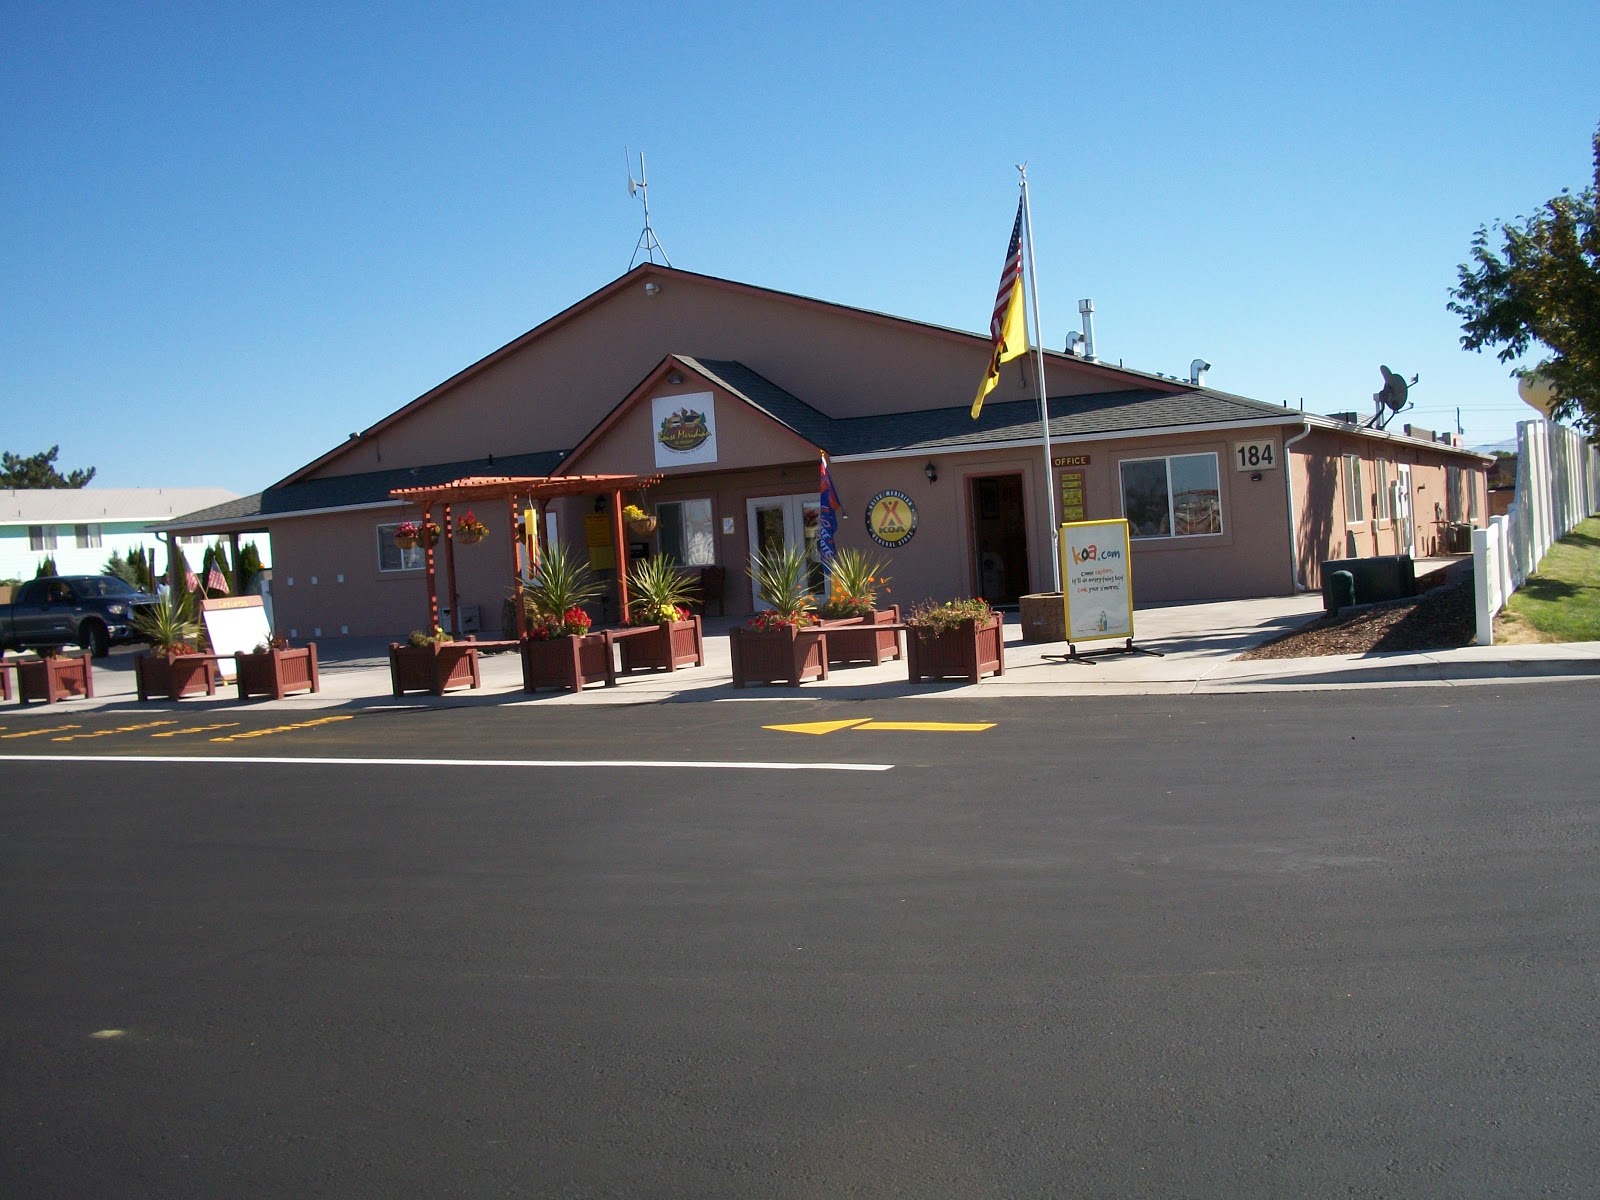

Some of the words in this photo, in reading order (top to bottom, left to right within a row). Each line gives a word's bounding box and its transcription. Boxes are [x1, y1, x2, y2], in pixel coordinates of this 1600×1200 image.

[678, 429, 712, 439] Meridian
[1055, 457, 1086, 466] OFFICE
[1238, 445, 1273, 466] 184
[879, 526, 905, 534] KOA
[872, 533, 896, 548] GENERAL
[898, 531, 913, 546] STORE
[1071, 544, 1121, 565] koa.com
[1088, 576, 1115, 584] everything
